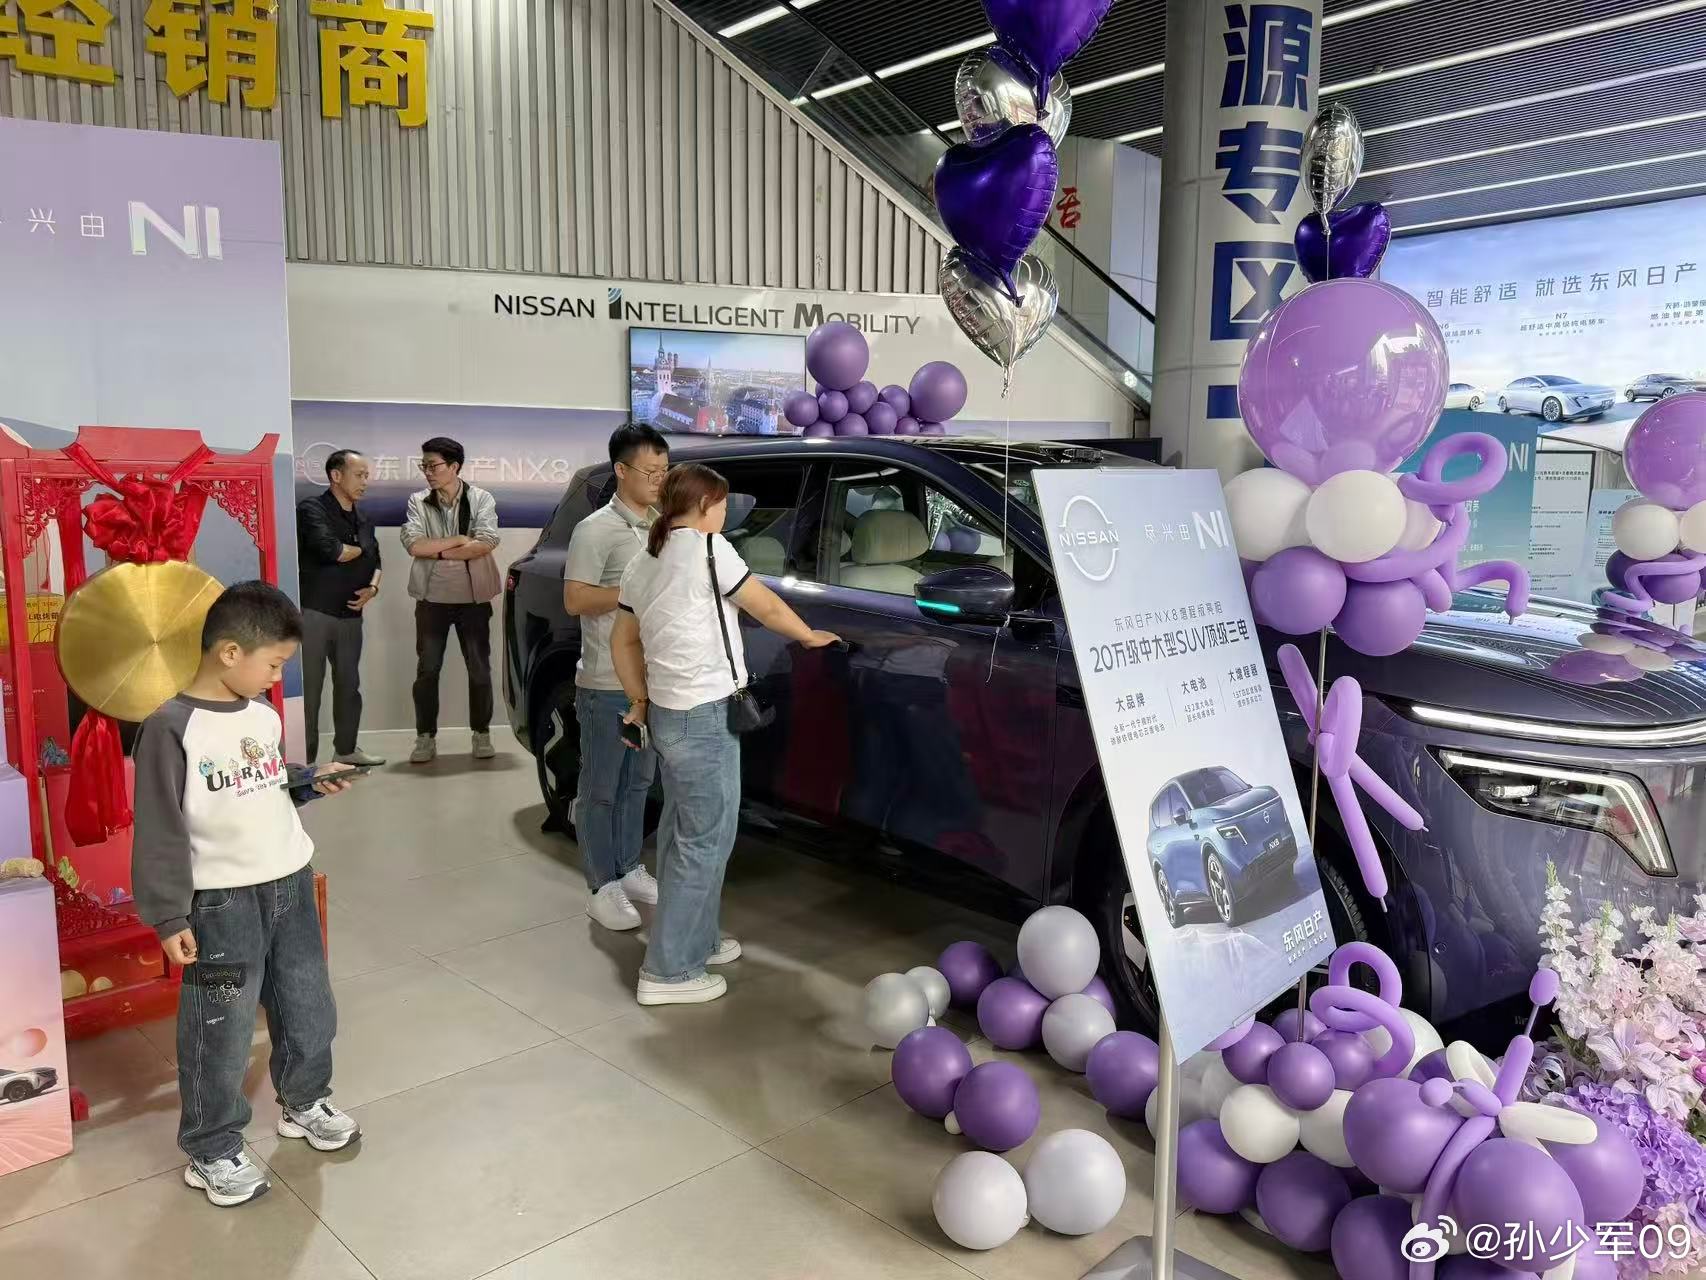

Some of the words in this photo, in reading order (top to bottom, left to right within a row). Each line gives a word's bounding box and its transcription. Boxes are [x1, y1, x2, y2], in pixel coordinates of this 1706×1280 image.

[128, 201, 223, 260] NI
[1427, 282, 1517, 308] 智能舒适
[1535, 262, 1697, 297] 就选东风日产
[494, 293, 595, 318] NISSAN
[608, 287, 785, 328] INTELLIGENT
[793, 302, 921, 335] MOBILITY
[1555, 312, 1568, 320] N7
[373, 455, 570, 484] 东产NX8
[1509, 441, 1529, 473] NI
[1059, 529, 1120, 547] NISSAN
[1192, 510, 1230, 550] NI
[1089, 618, 1250, 674] 20万级中大型SUV顶级三电
[1181, 676, 1208, 696] 大电池
[1227, 663, 1259, 683] 大增程器
[1115, 692, 1146, 713] 大品牌
[1282, 910, 1323, 952] 东风日产
